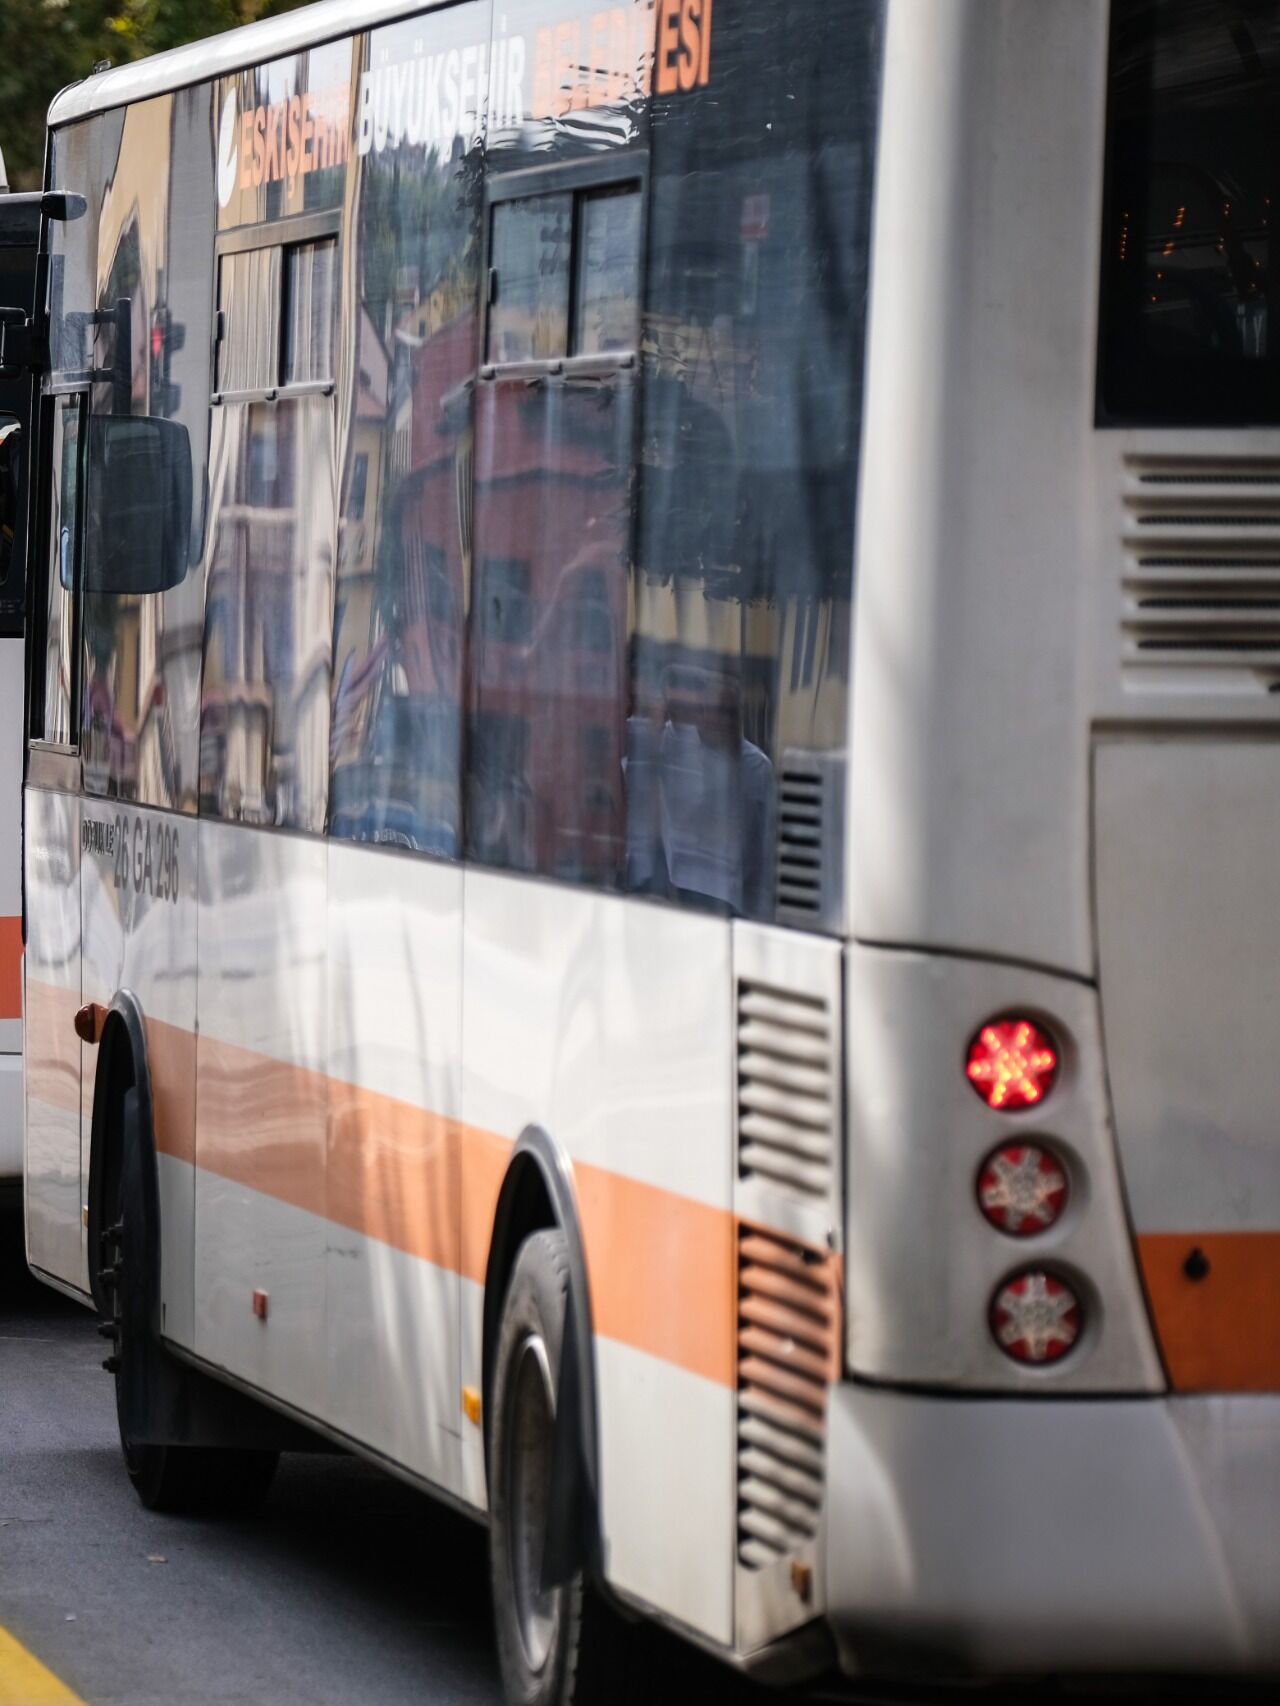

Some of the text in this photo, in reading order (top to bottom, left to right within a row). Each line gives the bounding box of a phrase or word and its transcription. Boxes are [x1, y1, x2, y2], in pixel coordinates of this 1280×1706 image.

[114, 814, 129, 889] 26
[133, 816, 153, 896] GA
[156, 821, 179, 904] 296
